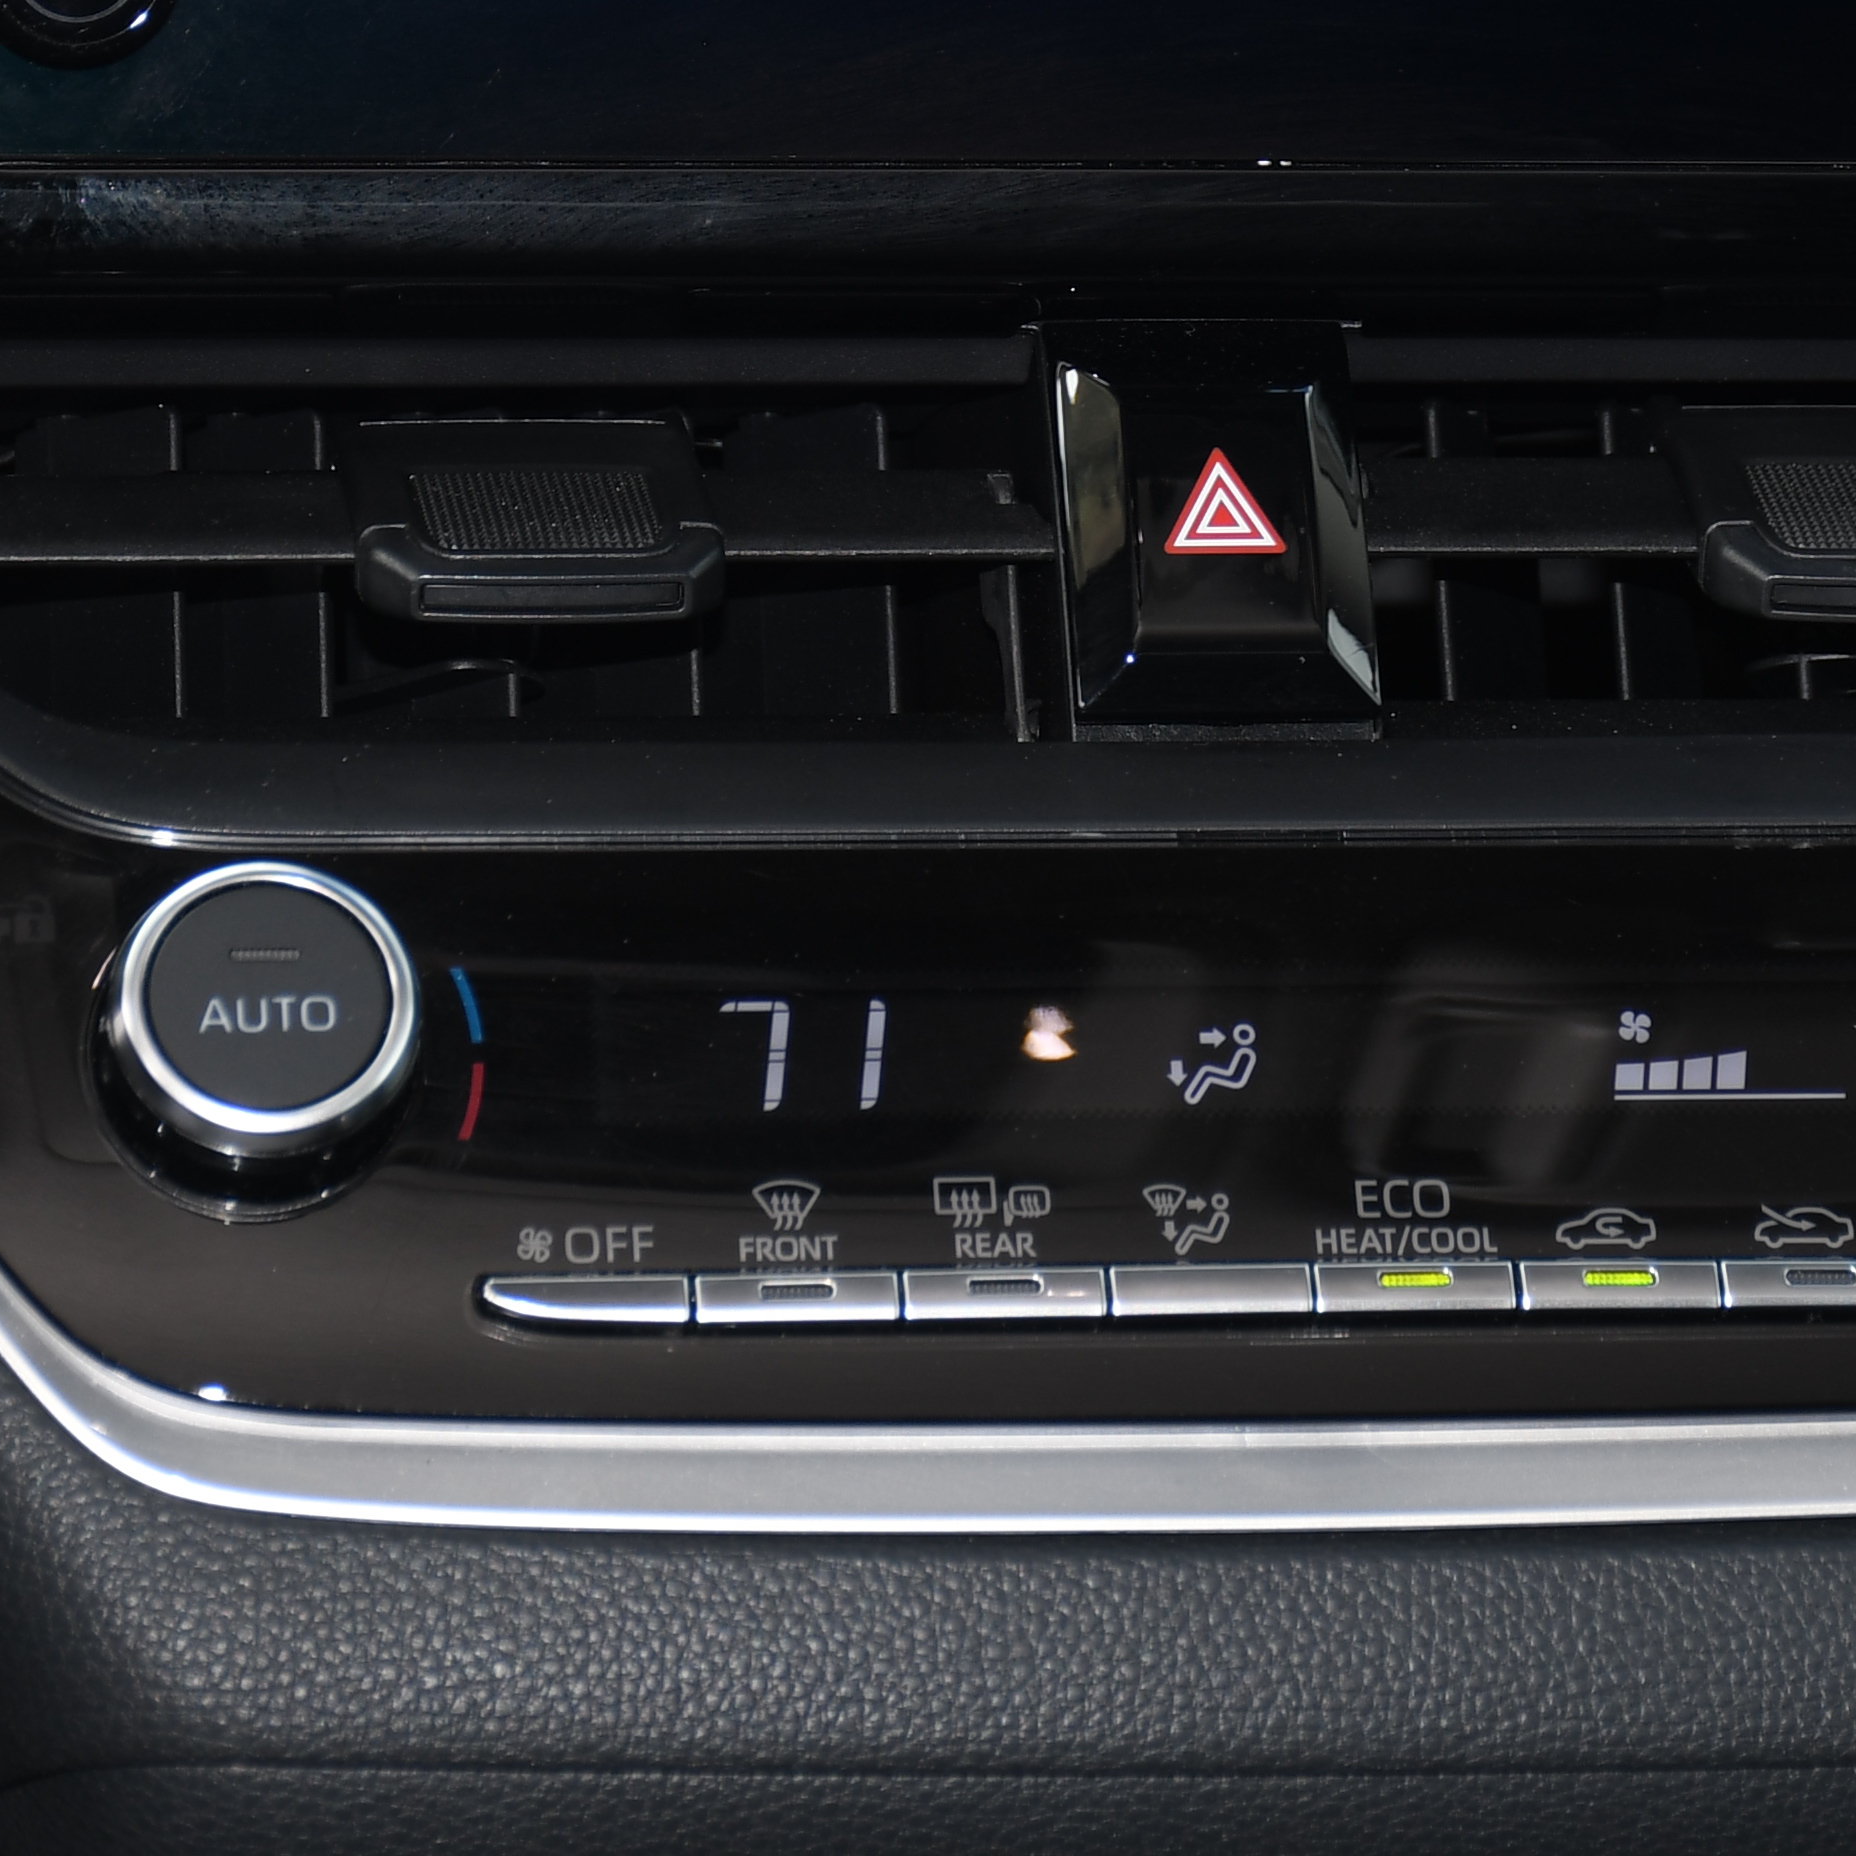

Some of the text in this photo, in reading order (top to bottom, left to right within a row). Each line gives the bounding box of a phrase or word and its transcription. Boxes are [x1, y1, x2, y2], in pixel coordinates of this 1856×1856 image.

[199, 996, 336, 1033] AUTO
[719, 999, 886, 1112] 71
[1354, 1178, 1451, 1219] ECO
[564, 1226, 654, 1264] OFF
[739, 1236, 837, 1262] FRONT
[955, 1233, 1036, 1258] REAR
[1315, 1225, 1498, 1256] HEAT/COOL
